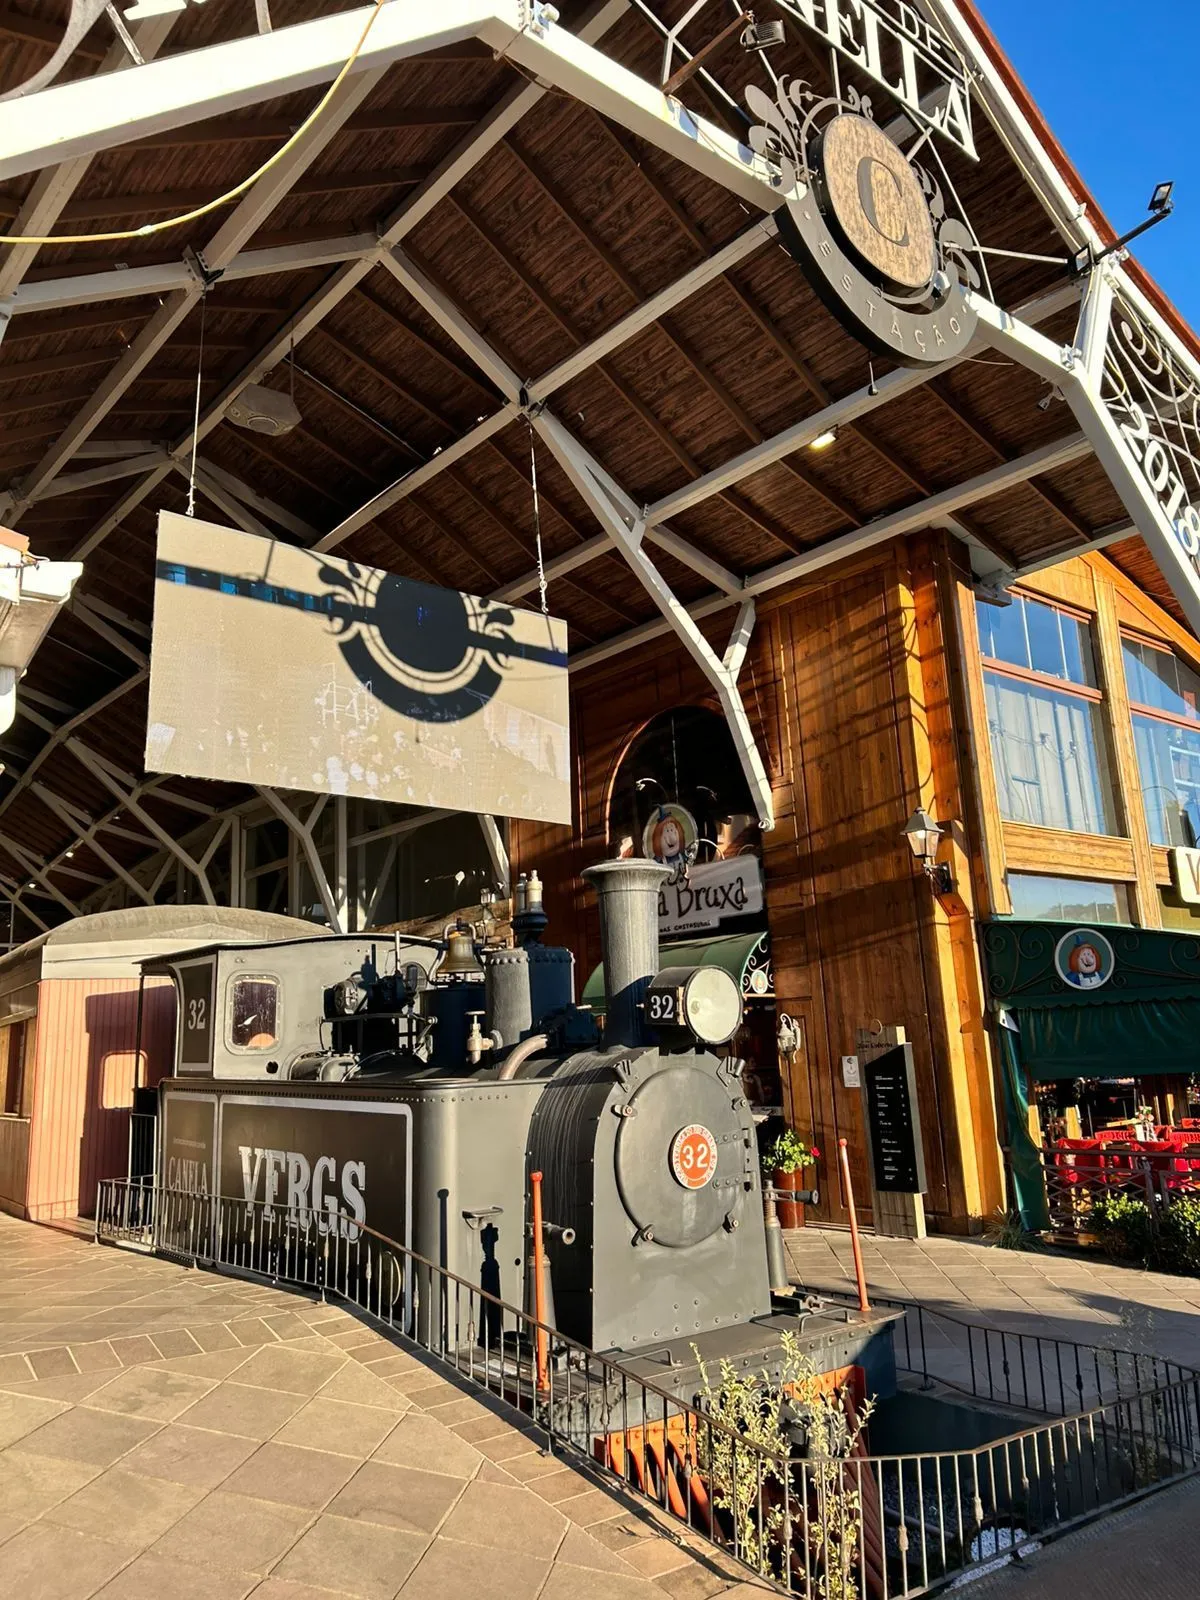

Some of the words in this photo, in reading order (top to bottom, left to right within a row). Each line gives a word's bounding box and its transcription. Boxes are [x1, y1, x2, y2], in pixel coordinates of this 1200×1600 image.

[857, 156, 910, 247] C
[818, 240, 961, 354] ESTAÇÃO
[1120, 400, 1200, 556] 2018
[675, 863, 749, 918] Bruxa
[188, 998, 206, 1030] 32
[650, 994, 674, 1019] 32
[682, 1143, 708, 1169] 32
[238, 1146, 367, 1244] VFRGS
